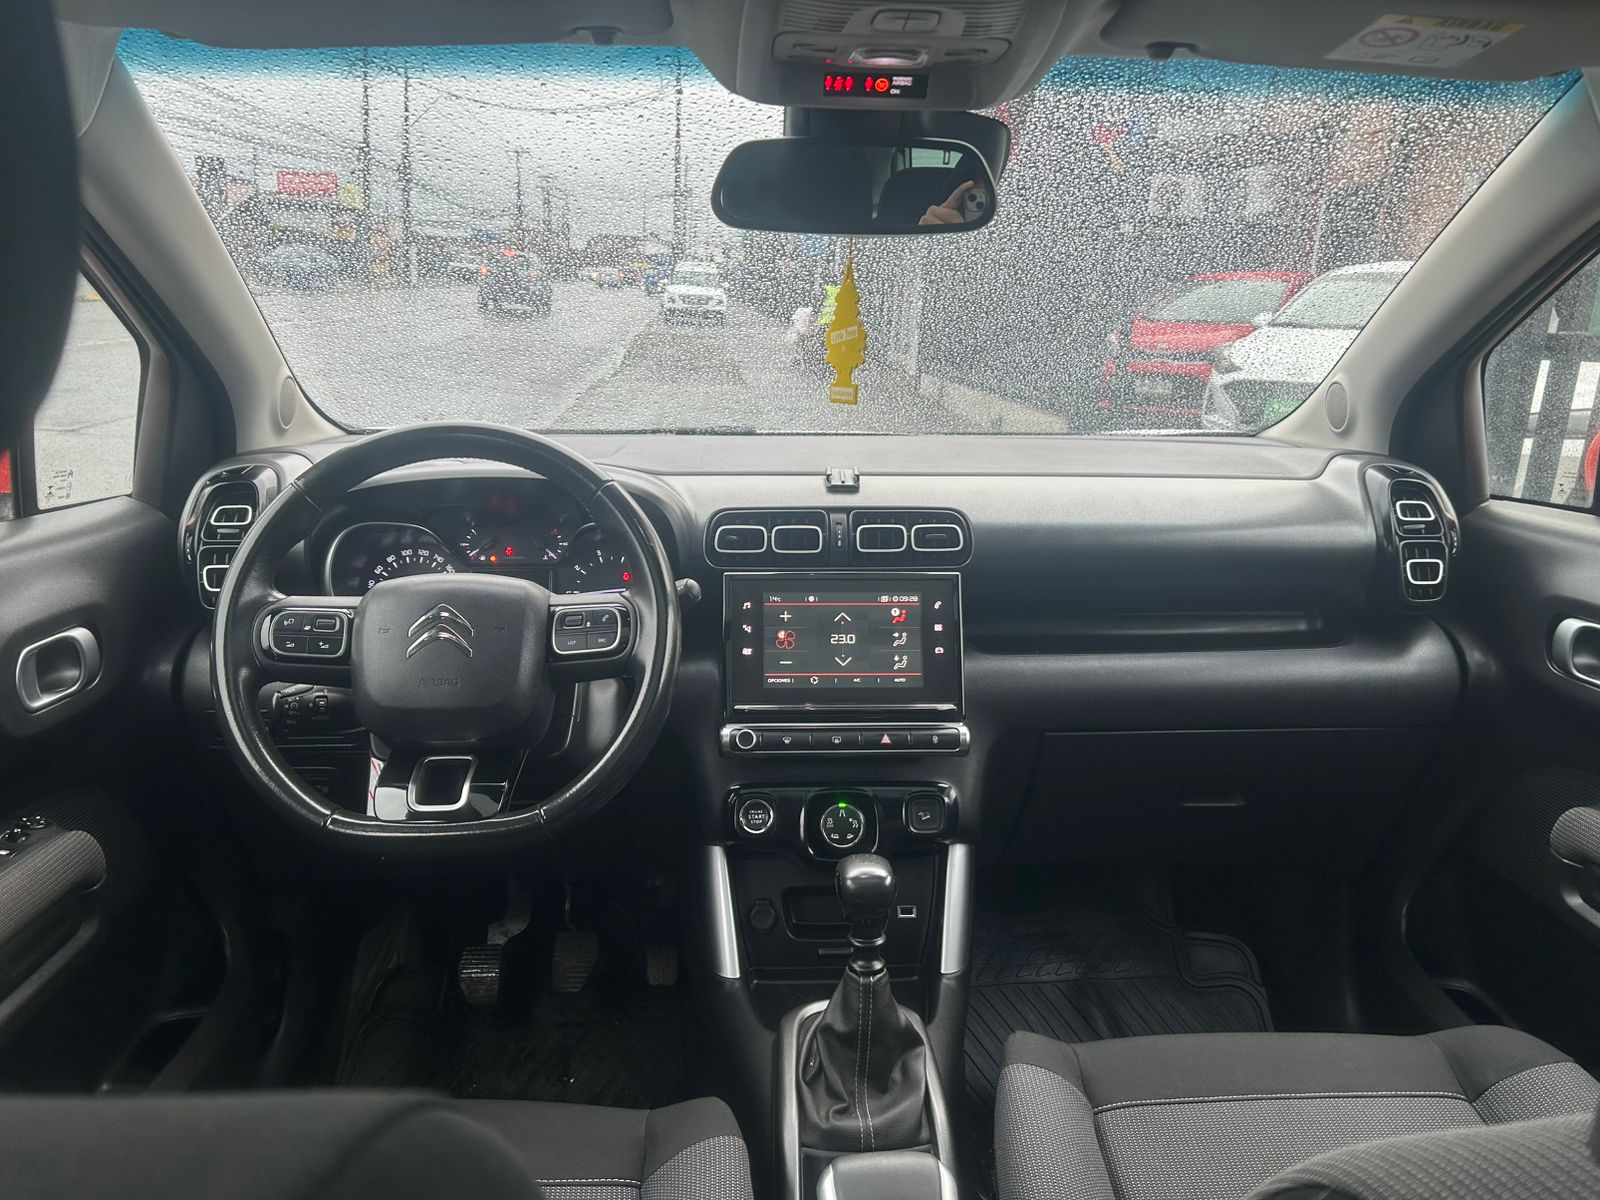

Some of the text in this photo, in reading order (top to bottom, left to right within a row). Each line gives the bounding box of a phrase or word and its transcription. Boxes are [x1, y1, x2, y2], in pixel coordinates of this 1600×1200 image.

[400, 548, 413, 557] 100
[417, 548, 430, 557] 120
[595, 549, 602, 557] 3
[385, 554, 397, 563] 80
[432, 553, 445, 563] 140
[373, 565, 384, 575] 60
[830, 634, 856, 645] 23.0
